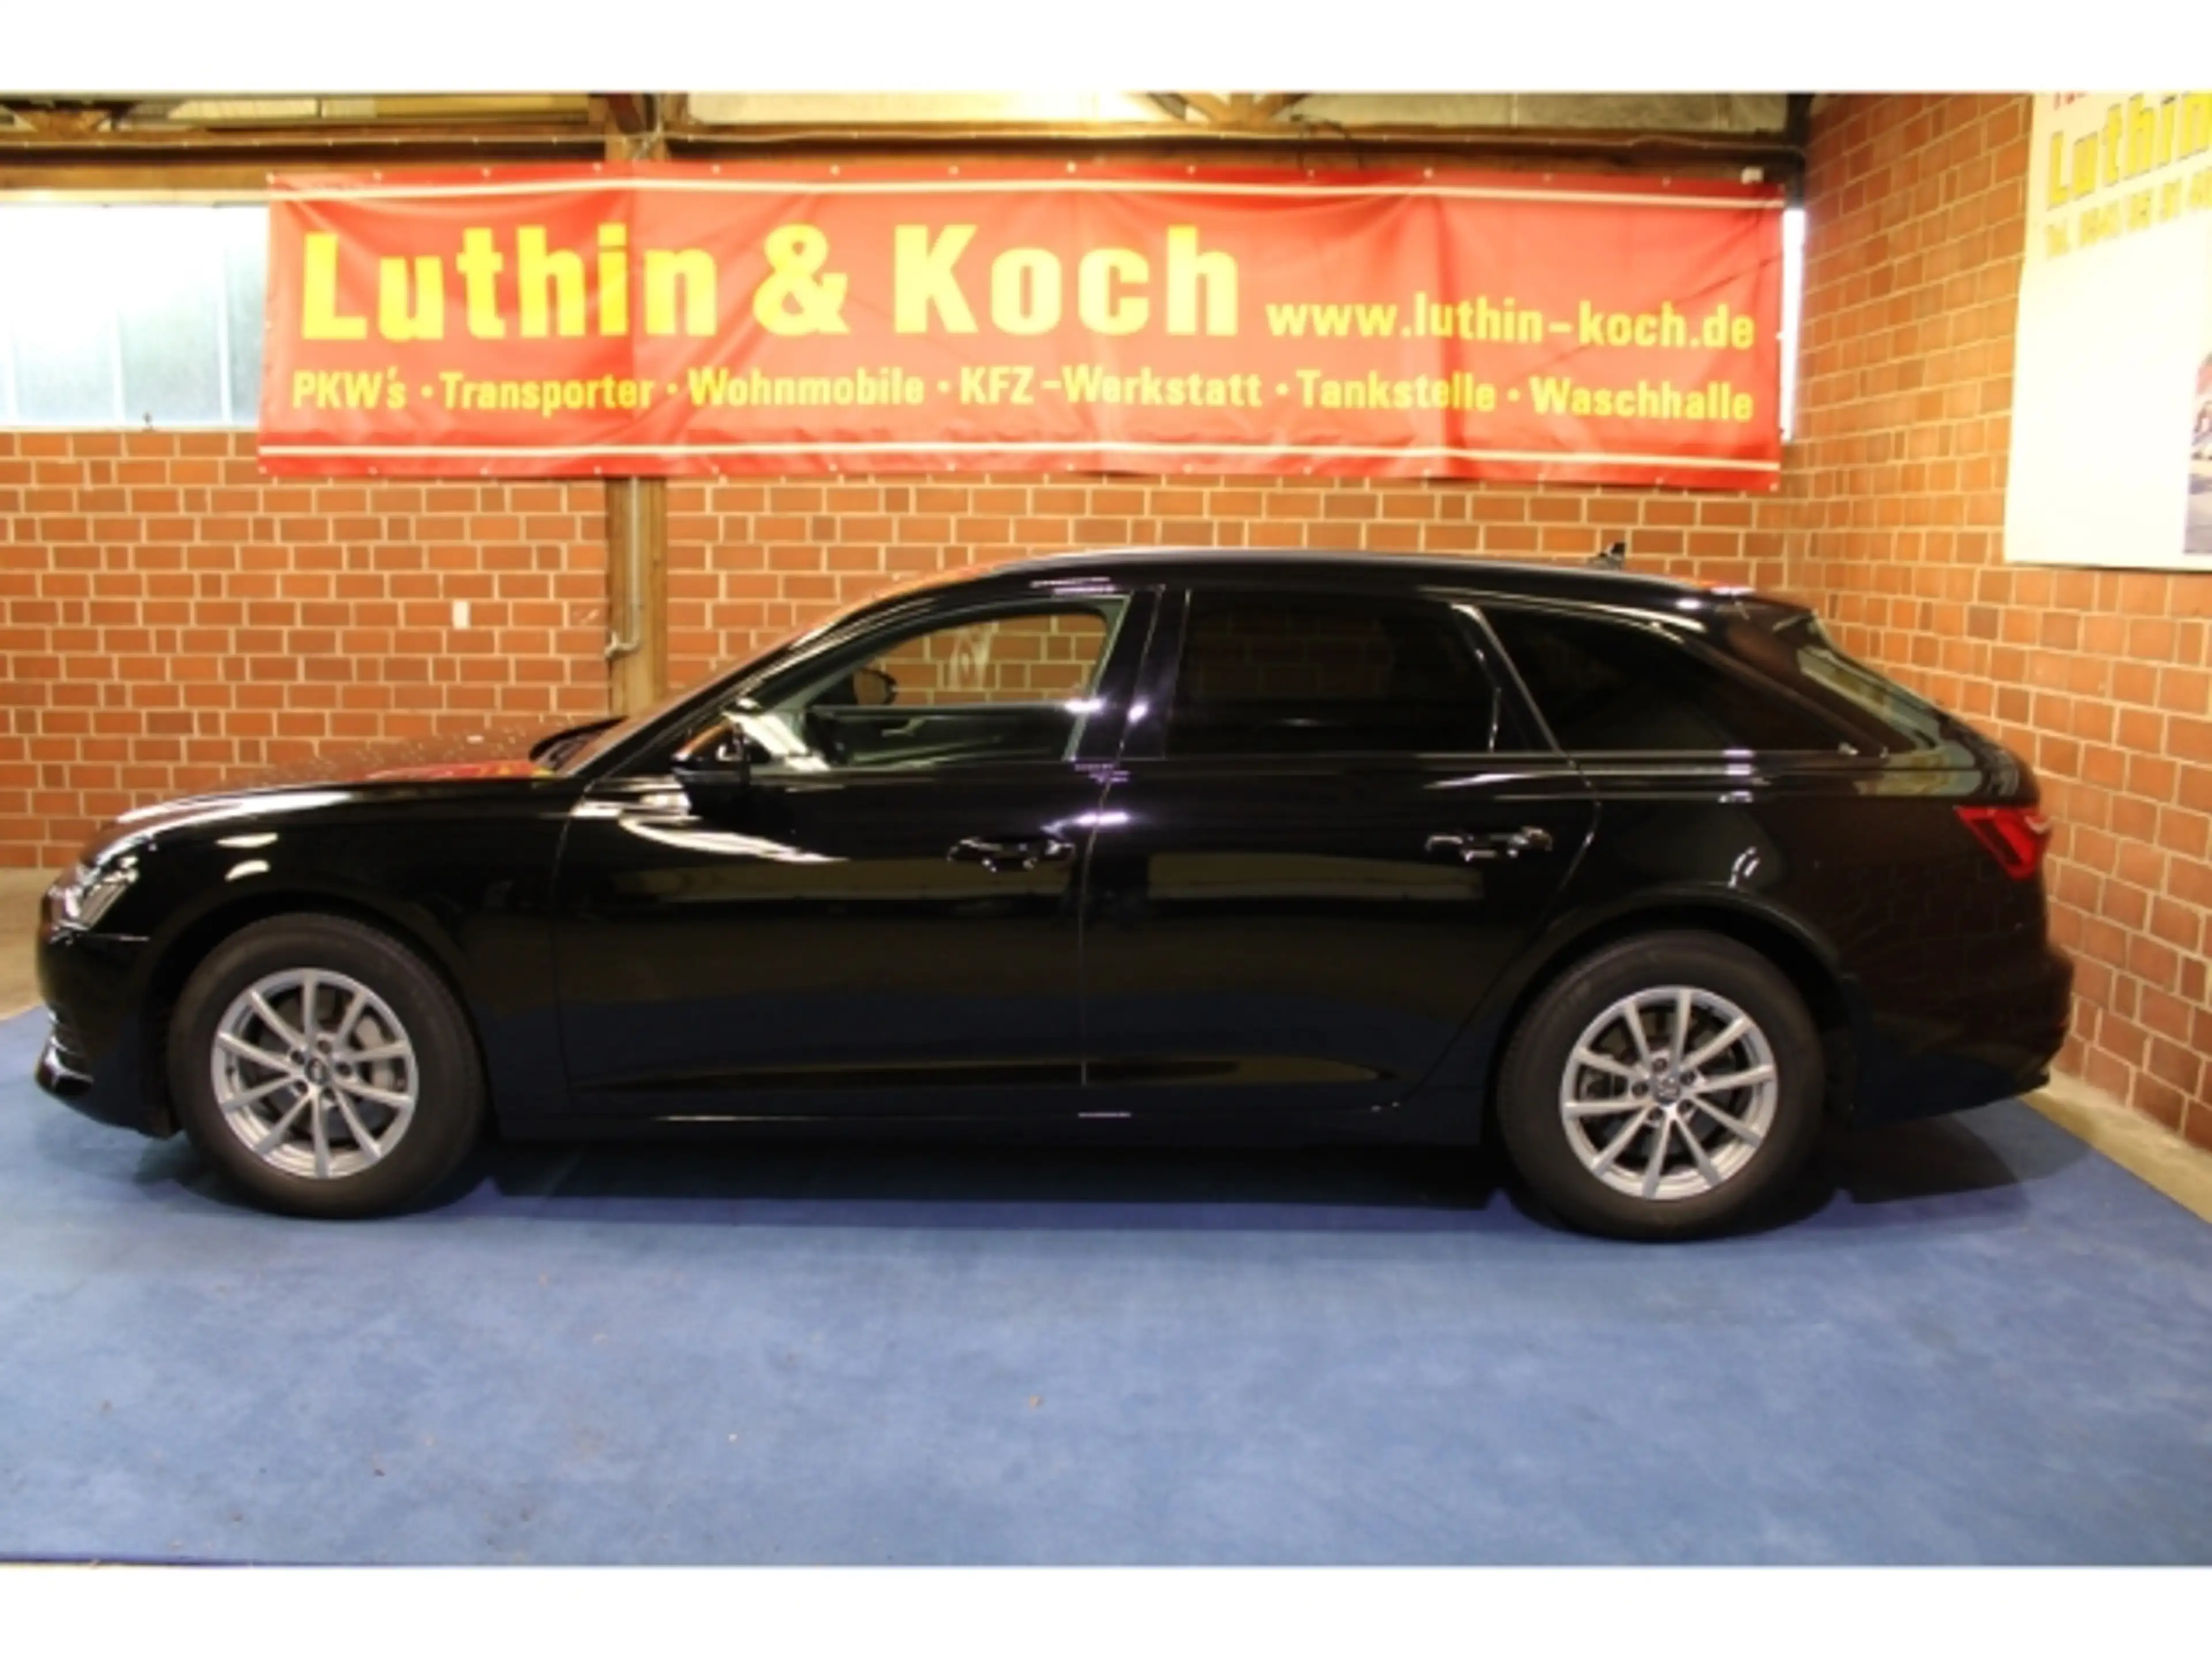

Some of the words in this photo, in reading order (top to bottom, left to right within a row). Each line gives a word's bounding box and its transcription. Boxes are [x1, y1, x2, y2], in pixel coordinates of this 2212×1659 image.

[301, 222, 718, 341] Luthin
[752, 224, 851, 337] &
[893, 224, 1239, 336] Koch
[1266, 292, 1755, 350] www.luthin-koch.de
[292, 365, 407, 411] PKW's
[438, 370, 656, 418] Transporter
[688, 365, 925, 410] Wohnmobile
[1296, 369, 1496, 414] Tankstelle
[1529, 375, 1753, 422] Waschhalle
